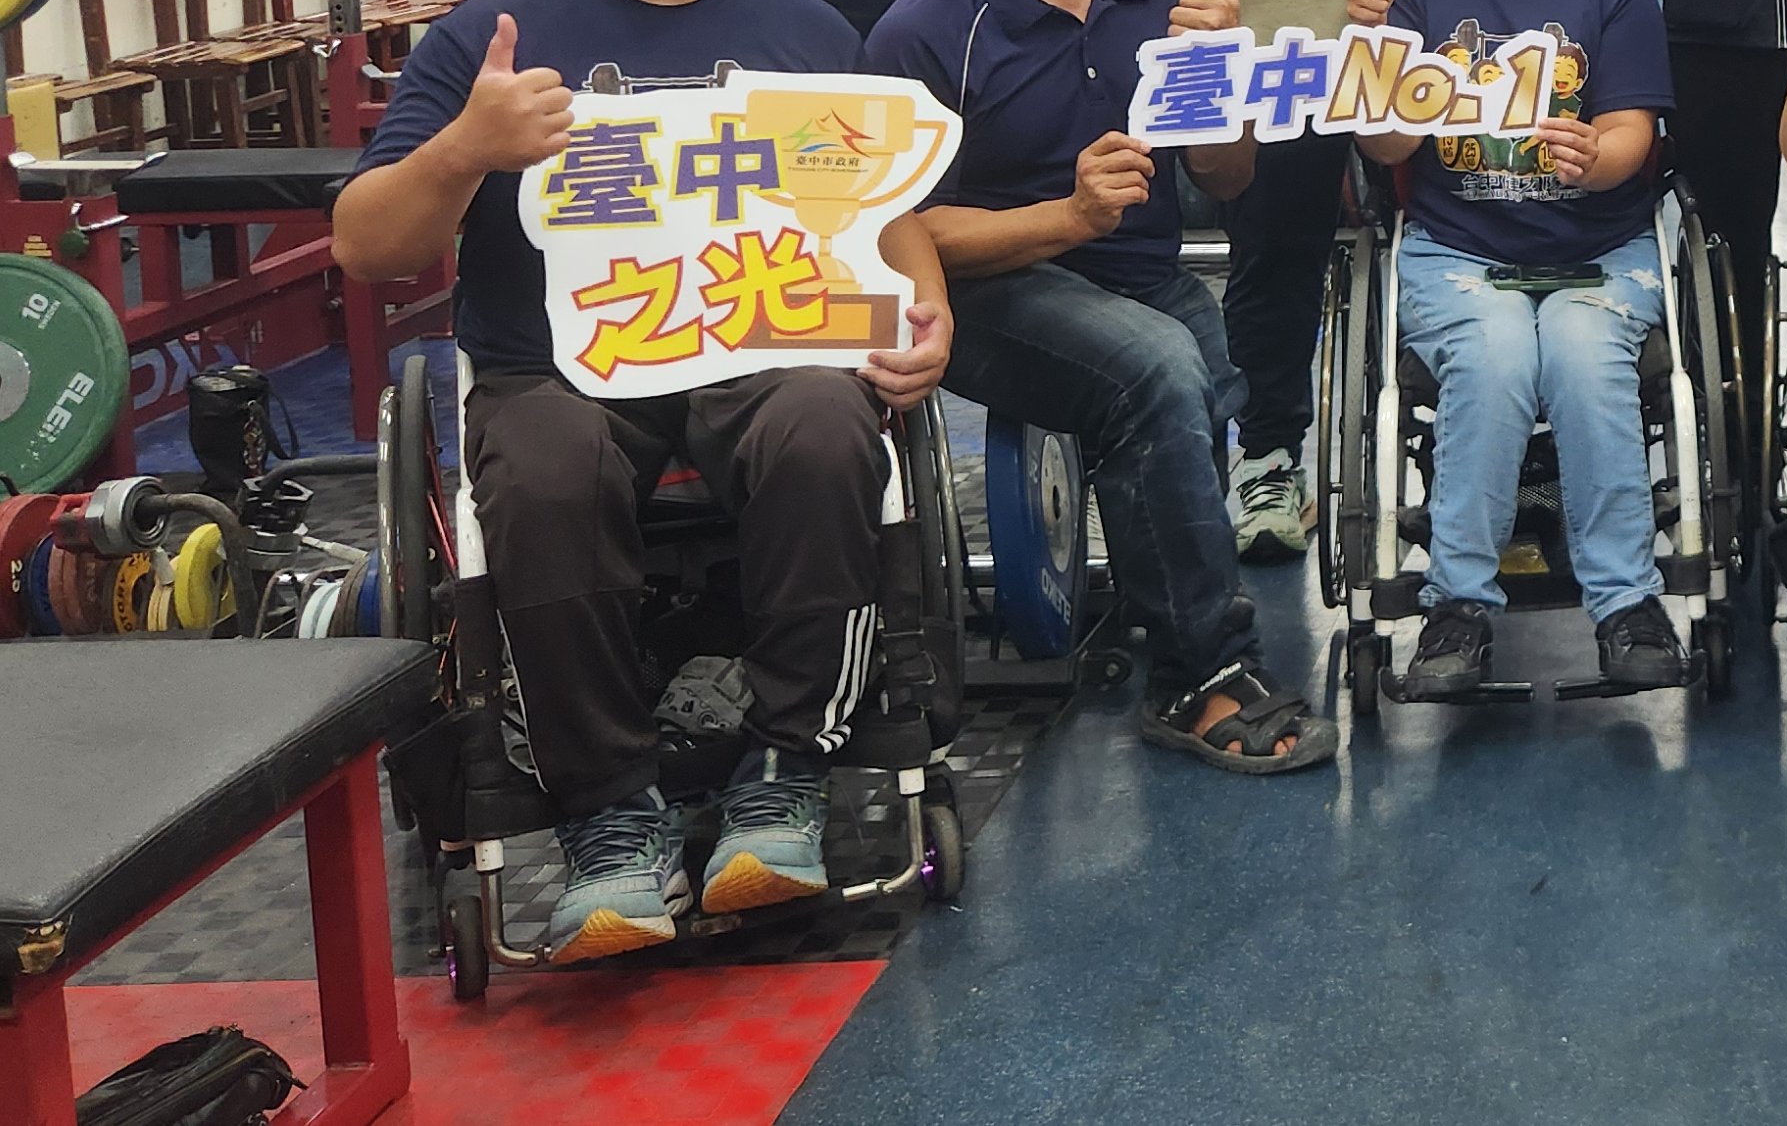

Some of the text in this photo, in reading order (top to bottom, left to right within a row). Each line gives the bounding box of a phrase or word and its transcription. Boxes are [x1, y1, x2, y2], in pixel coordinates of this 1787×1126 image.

[545, 116, 783, 227] 臺中
[1465, 143, 1476, 158] 25
[22, 293, 49, 320] 10
[571, 227, 829, 381] 之光
